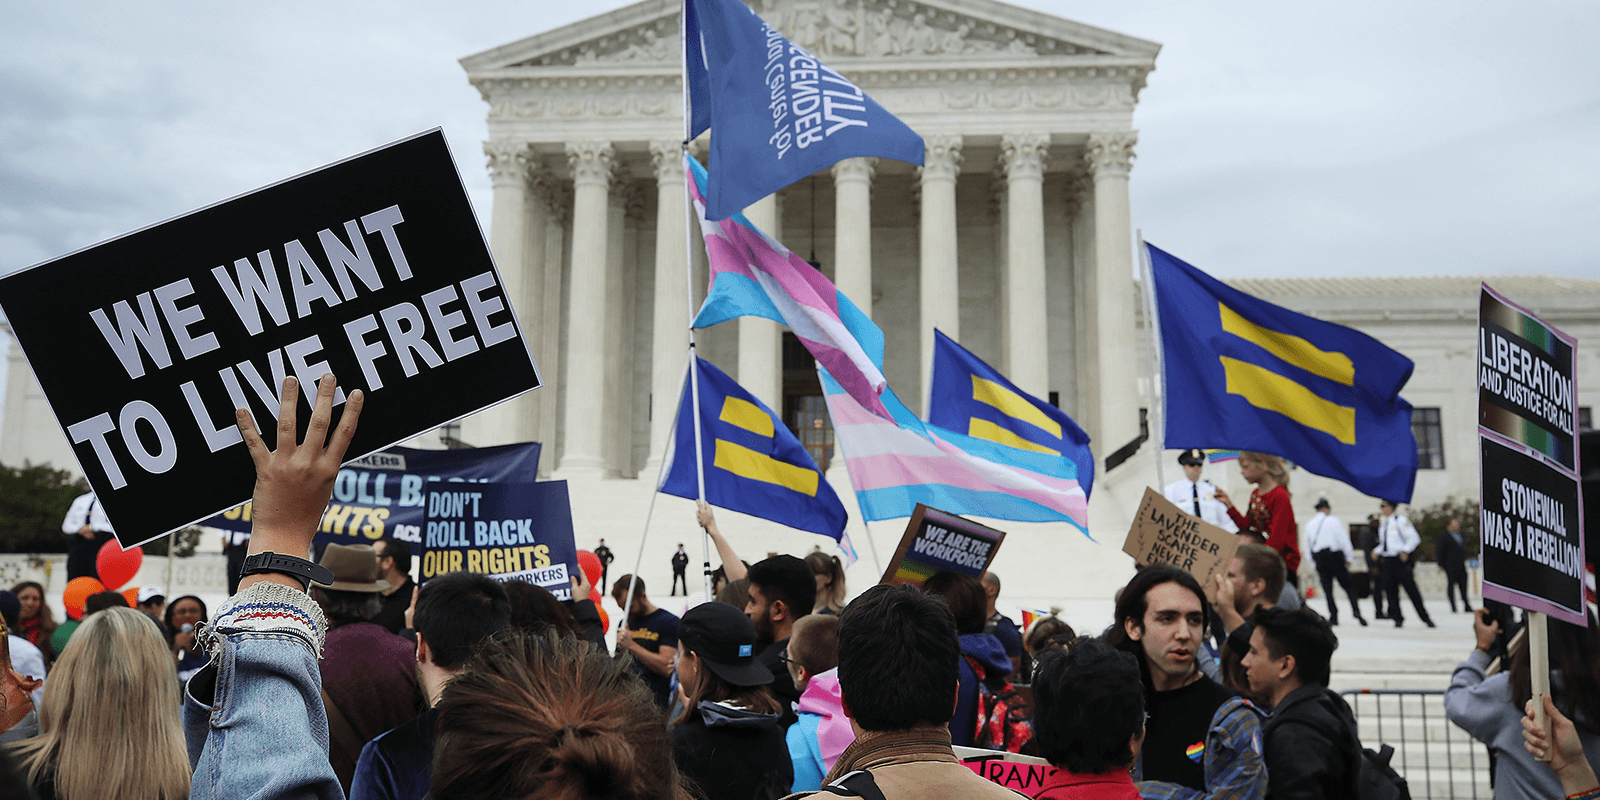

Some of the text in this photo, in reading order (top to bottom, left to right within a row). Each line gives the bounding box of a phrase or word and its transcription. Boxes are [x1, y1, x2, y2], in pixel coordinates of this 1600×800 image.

[89, 204, 413, 379] WE WANT
[68, 271, 517, 490] TO LIVE FREE
[1481, 327, 1572, 414] LIBERATION
[1480, 366, 1574, 436] AND JUSTICE FOR ALL
[331, 469, 392, 506] OLL
[428, 491, 482, 518] DON'T
[320, 504, 390, 540] HTS
[1176, 512, 1200, 533] THE
[1502, 477, 1566, 537] STONEWALL
[393, 523, 422, 543] ACL
[425, 518, 535, 548] ROLL BACK
[925, 524, 991, 556] WE ARE THE
[1151, 508, 1219, 556] LAVENDER
[1157, 529, 1198, 561] SCARE
[1483, 509, 1581, 580] WAS A REBELLION
[423, 544, 551, 578] OUR RIGHTS
[914, 537, 987, 570] WORKFORCE
[1152, 542, 1193, 571] NEVER
